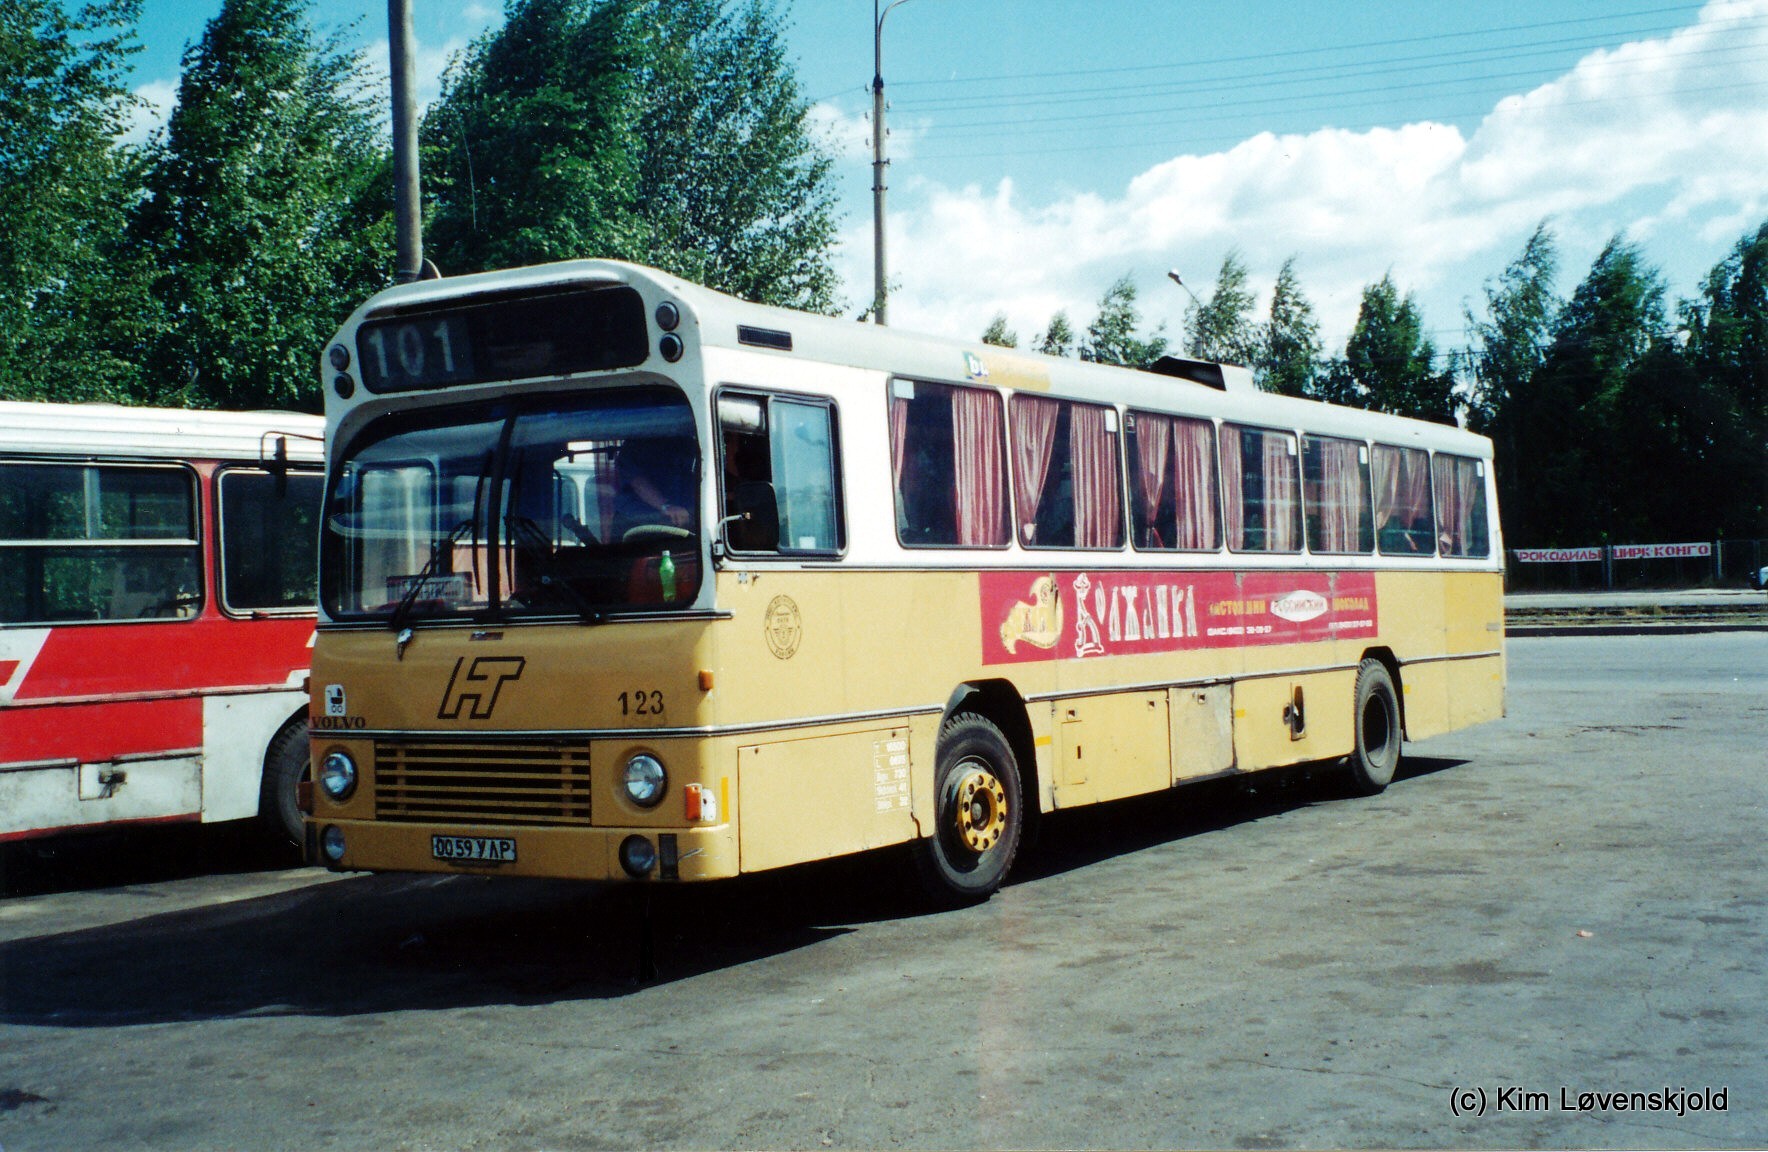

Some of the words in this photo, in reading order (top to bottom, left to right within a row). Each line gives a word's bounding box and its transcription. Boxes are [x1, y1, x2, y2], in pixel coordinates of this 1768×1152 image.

[367, 319, 454, 379] 101
[1613, 547, 1649, 559] ЦИРК
[1653, 545, 1709, 556] КОНГО
[618, 690, 664, 716] 123
[311, 716, 366, 729] VOLVO
[476, 840, 511, 859] УЛР
